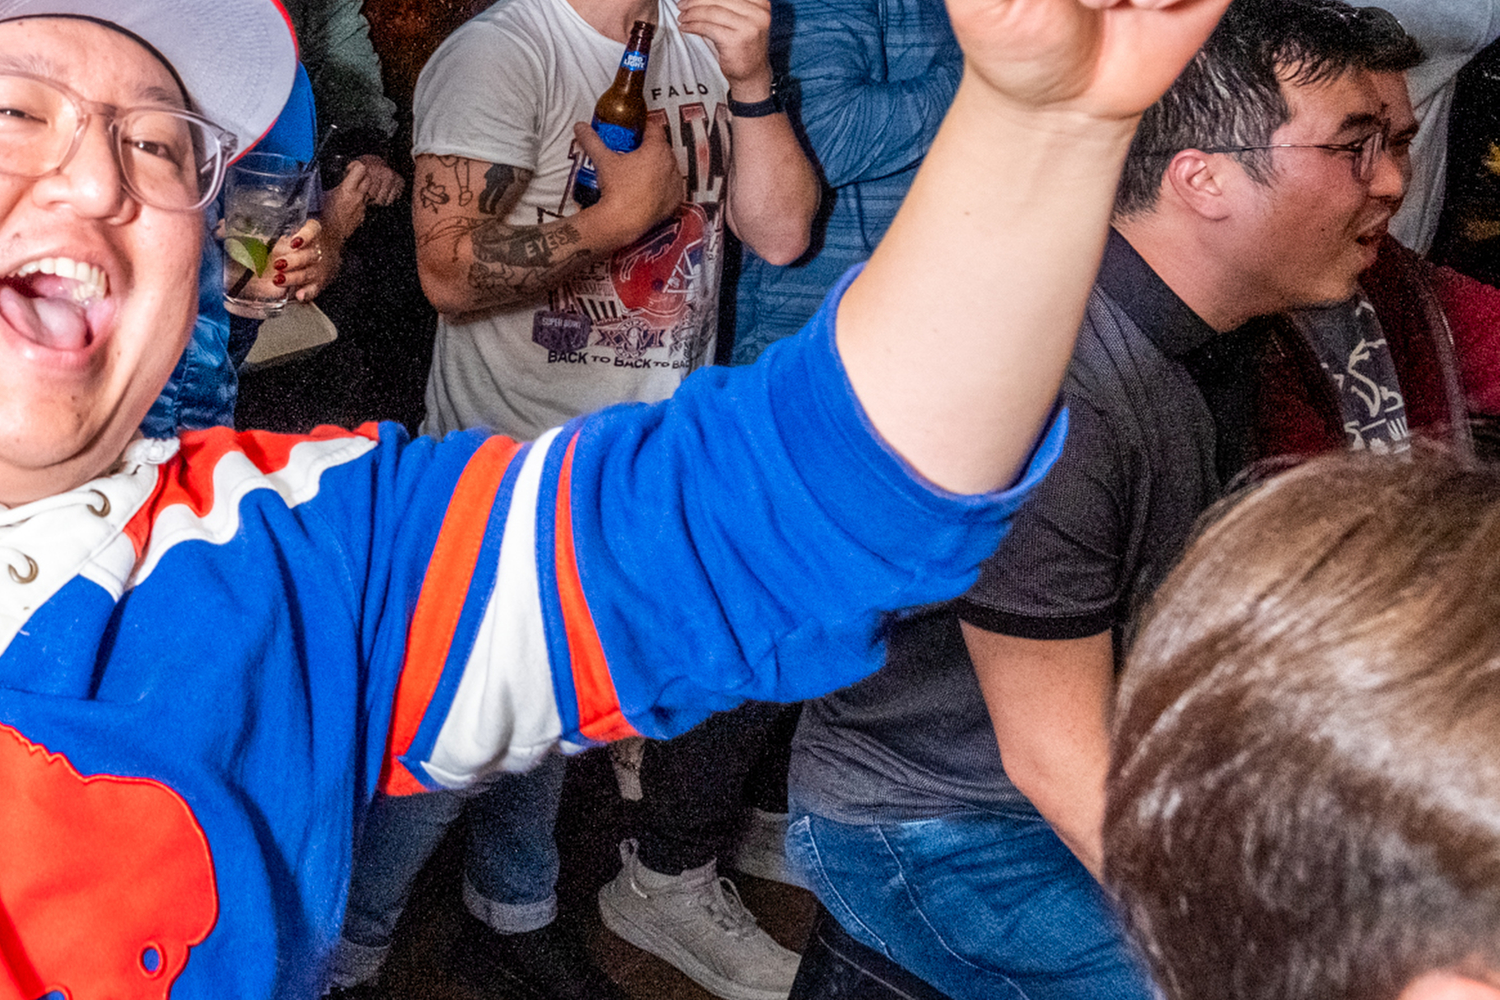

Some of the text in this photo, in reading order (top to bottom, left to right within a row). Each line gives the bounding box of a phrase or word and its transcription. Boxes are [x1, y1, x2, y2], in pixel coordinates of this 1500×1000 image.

[651, 82, 710, 101] FALO
[524, 229, 570, 258] EYES
[541, 317, 563, 328] SUPER
[548, 351, 588, 365] BACK
[591, 355, 611, 363] TO
[613, 358, 651, 369] BACK
